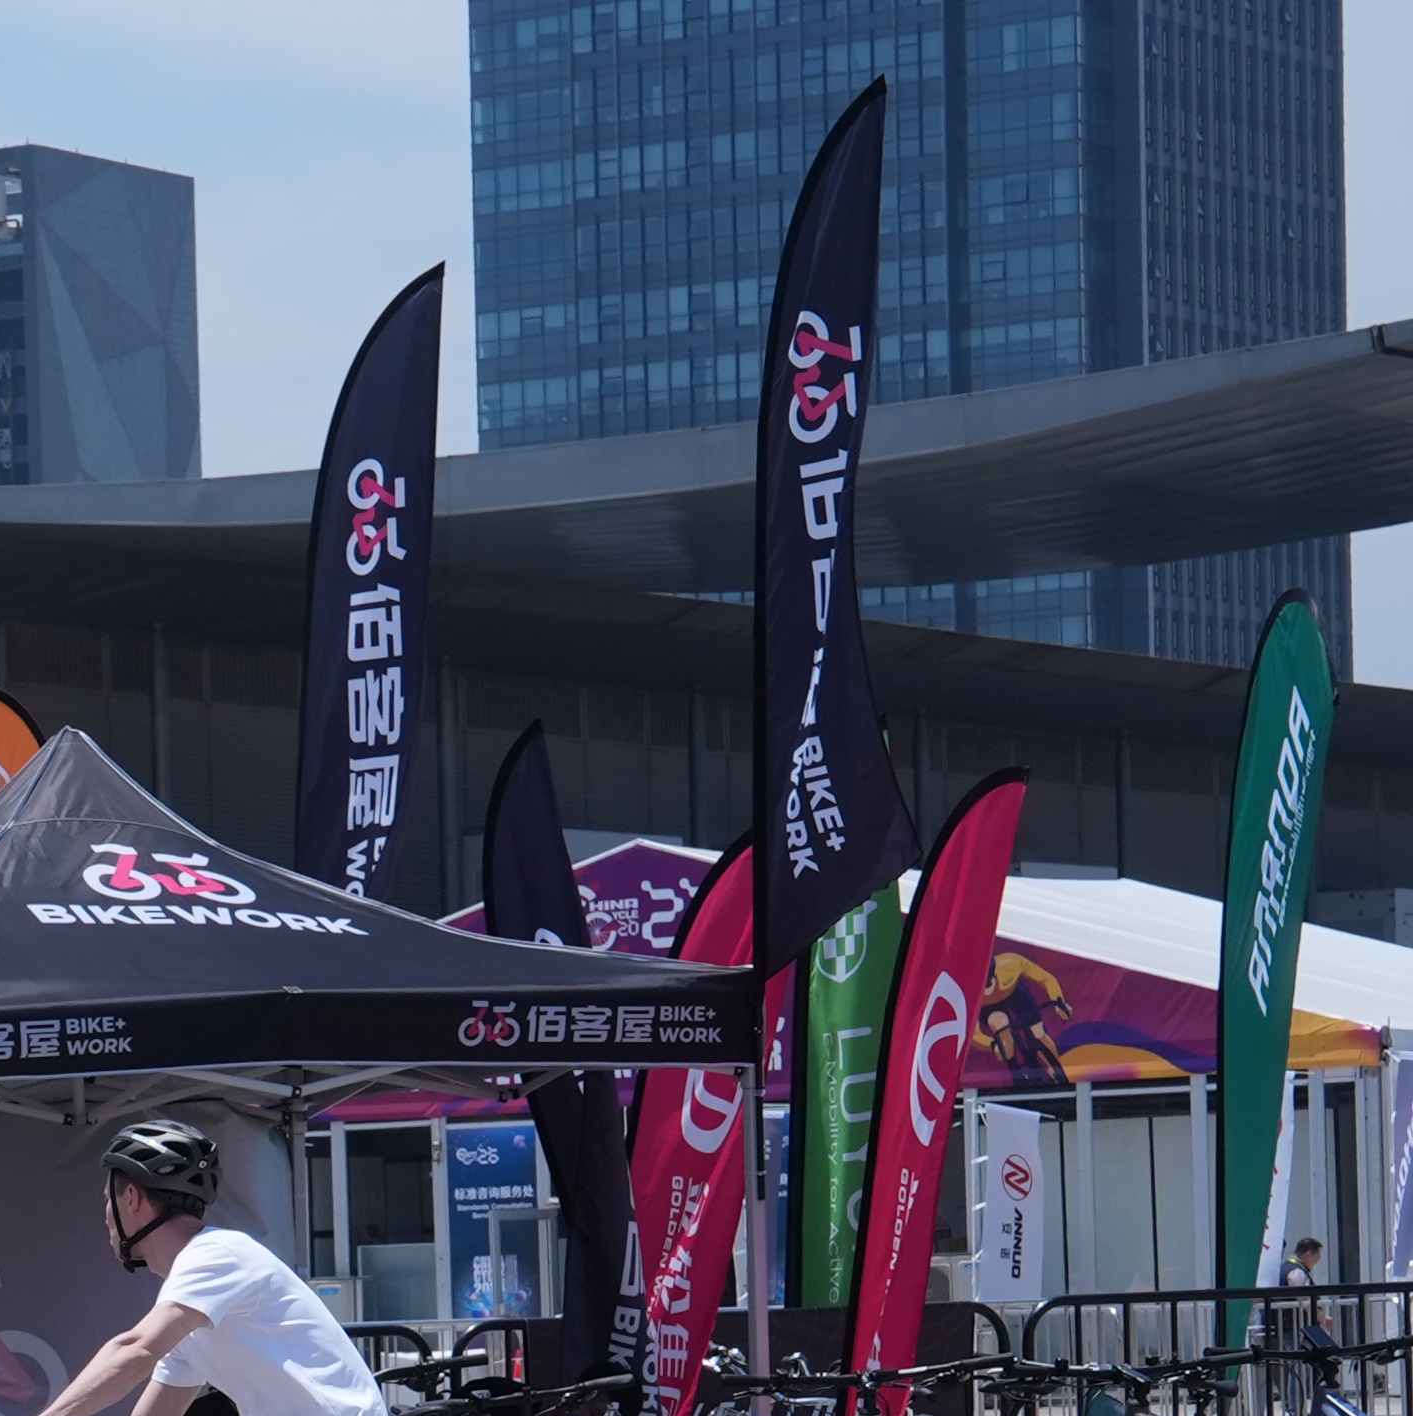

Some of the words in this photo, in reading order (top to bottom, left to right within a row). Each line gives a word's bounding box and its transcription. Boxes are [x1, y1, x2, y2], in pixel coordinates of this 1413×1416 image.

[346, 582, 405, 832] 佰客屋
[26, 903, 370, 936] BIKEWORK
[65, 1016, 127, 1035] BIKE+
[526, 1004, 655, 1044] 佰客屋
[659, 1005, 717, 1023] BIKE+
[66, 1036, 133, 1056] WORK
[659, 1026, 723, 1044] WORK
[657, 1175, 684, 1269] GOLDEN
[890, 1167, 910, 1271] GOLDEN
[1011, 1206, 1024, 1280] ANNUO
